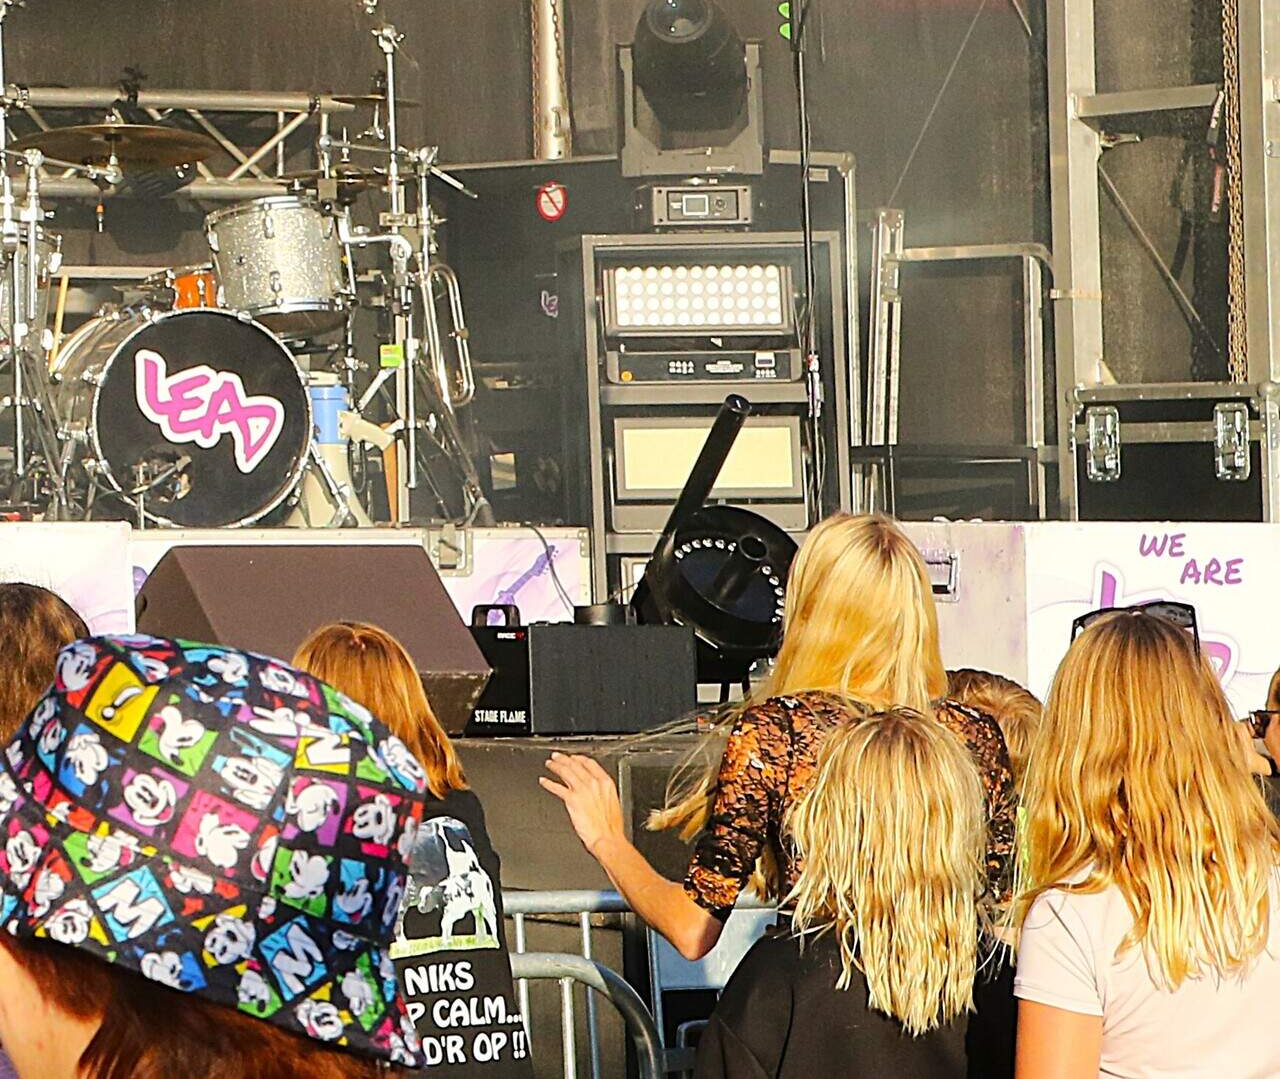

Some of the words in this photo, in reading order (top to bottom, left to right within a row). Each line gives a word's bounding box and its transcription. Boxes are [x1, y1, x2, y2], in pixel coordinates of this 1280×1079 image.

[141, 355, 280, 466] LEAD
[1139, 533, 1186, 557] WE
[1180, 557, 1244, 585] ARE
[404, 962, 475, 996] NIKS
[473, 1032, 508, 1062] OP
[512, 1030, 526, 1059] !!
